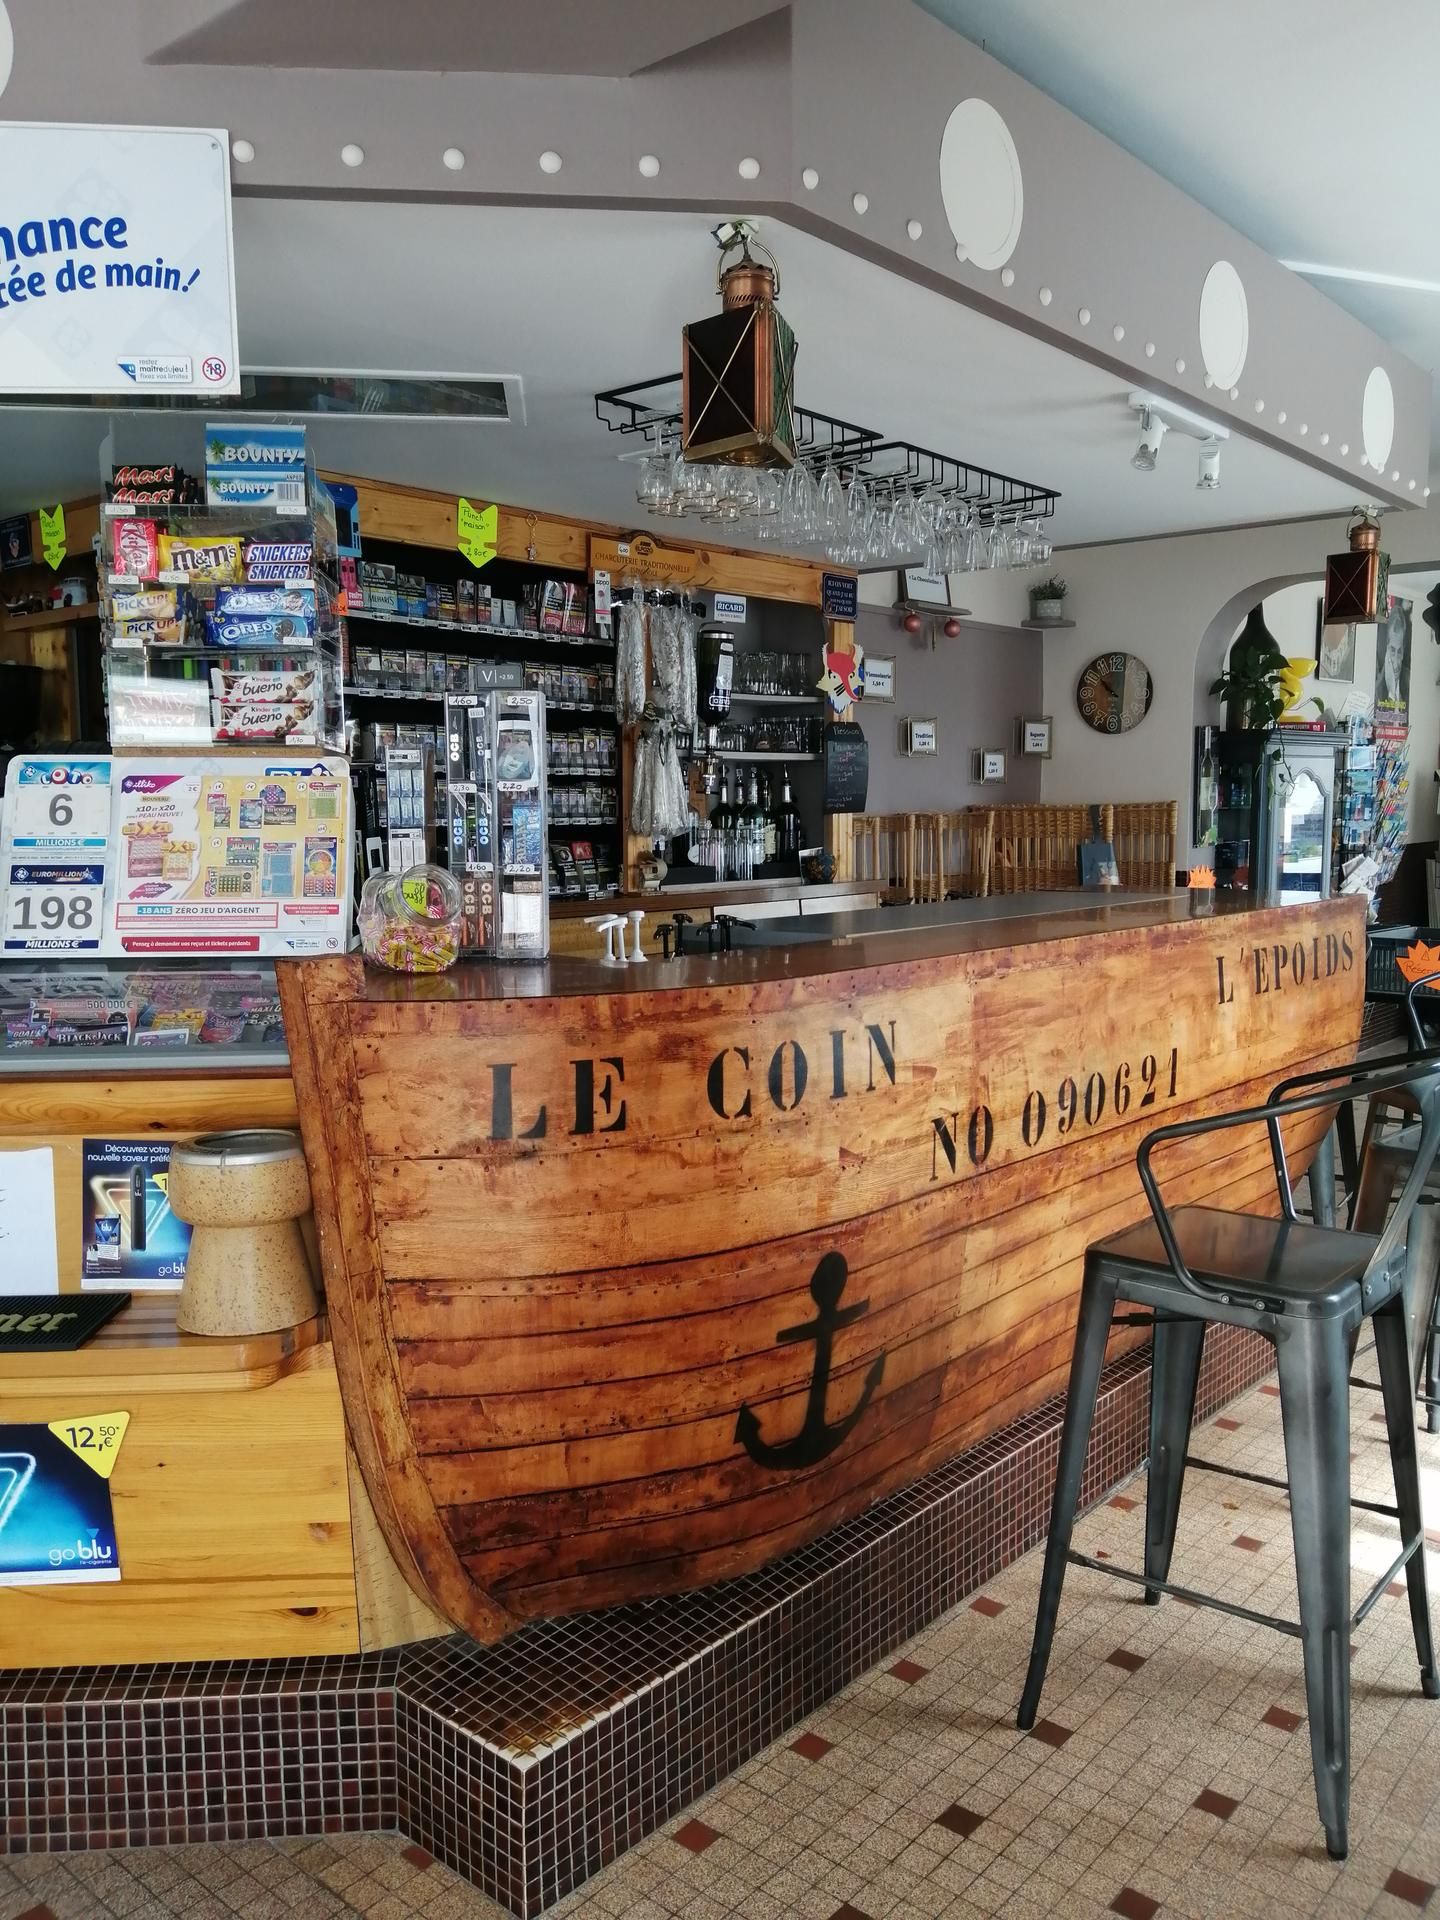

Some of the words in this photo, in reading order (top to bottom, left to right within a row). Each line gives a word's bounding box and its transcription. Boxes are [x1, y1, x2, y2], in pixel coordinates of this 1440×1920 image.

[56, 259, 96, 293] de
[224, 447, 298, 464] BOUNTY
[114, 466, 176, 487] Mars
[112, 487, 176, 503] Mars
[219, 483, 271, 494] BOUNTY
[461, 507, 484, 521] Punch
[250, 545, 310, 562] SNICKERS
[595, 552, 638, 566] CHARCUTERIE
[640, 558, 691, 574] TRADITIONNELLE
[249, 564, 308, 580] SNICKERS
[230, 593, 281, 608] OREO
[717, 603, 744, 612] RICARD
[222, 621, 273, 638] OREO
[1109, 655, 1124, 671] 12
[242, 682, 283, 696] bueno
[1080, 687, 1094, 699] 9
[1083, 701, 1097, 715] 8
[241, 712, 283, 726] bueno
[1107, 715, 1118, 731] 6
[450, 733, 459, 762] OCB
[475, 735, 484, 756] OCB
[41, 768, 92, 784] LOTO
[49, 793, 73, 826] 6
[453, 817, 463, 845] OCB
[479, 817, 489, 845] OCB
[35, 838, 76, 846] MILLIONS
[464, 882, 475, 915] OCB
[481, 882, 493, 915] OCB
[13, 896, 93, 930] 198
[175, 904, 198, 915] ZÉRO
[200, 906, 215, 914] JEU
[217, 905, 260, 914] D'ARGENT
[25, 940, 71, 948] MILLIONS
[1215, 930, 1355, 1005] L'EPOIDS
[486, 1056, 627, 1141] LE
[706, 1018, 897, 1120] COIN
[930, 1104, 994, 1182] NO
[1021, 1047, 1178, 1148] 090621
[105, 1144, 147, 1153] Découvrez
[149, 1145, 170, 1153] votre
[87, 1153, 120, 1161] nouvelle
[101, 1223, 112, 1232] blu
[158, 1265, 172, 1276] go
[104, 1436, 113, 1448] €
[49, 1548, 75, 1566] go
[77, 1539, 111, 1559] blu
